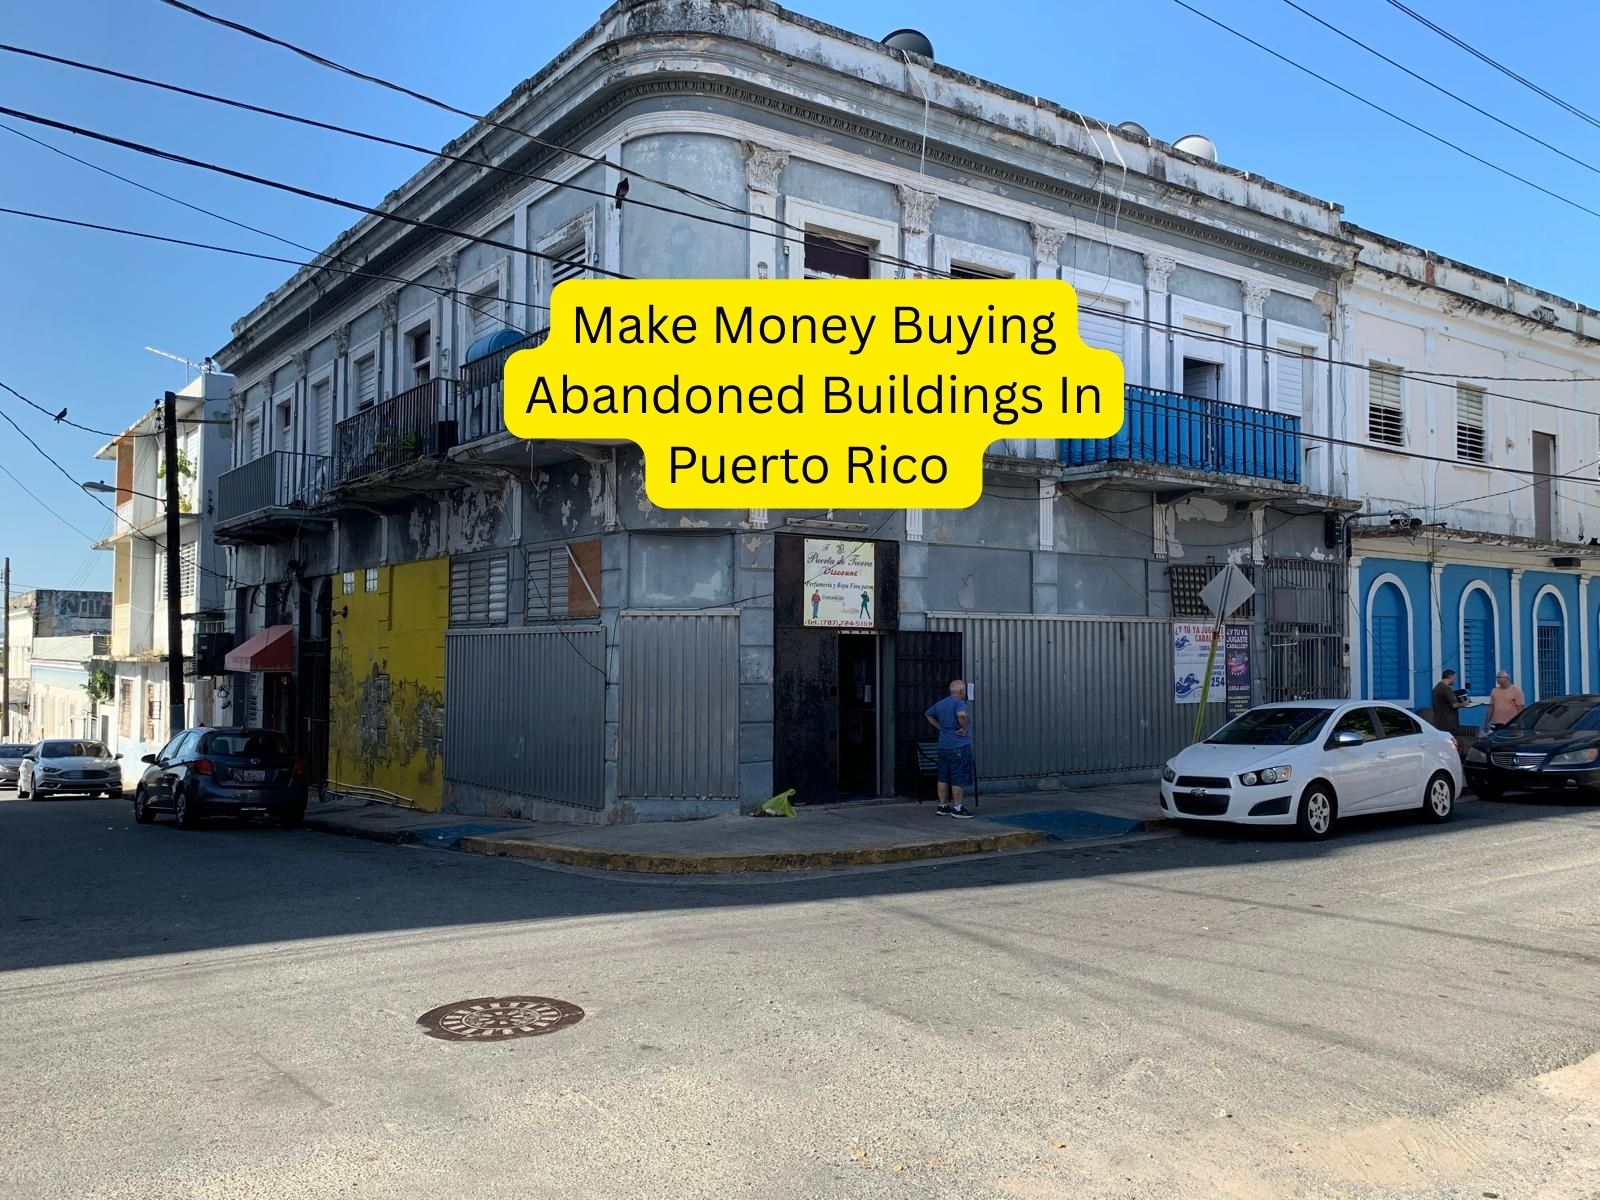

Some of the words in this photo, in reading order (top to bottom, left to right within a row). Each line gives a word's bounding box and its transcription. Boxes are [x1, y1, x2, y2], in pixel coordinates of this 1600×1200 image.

[807, 551, 835, 565] Puerta
[837, 555, 846, 565] de
[848, 554, 873, 567] Tierra
[837, 581, 849, 590] Ropa
[1193, 625, 1200, 634] YA
[1211, 676, 1225, 688] 254
